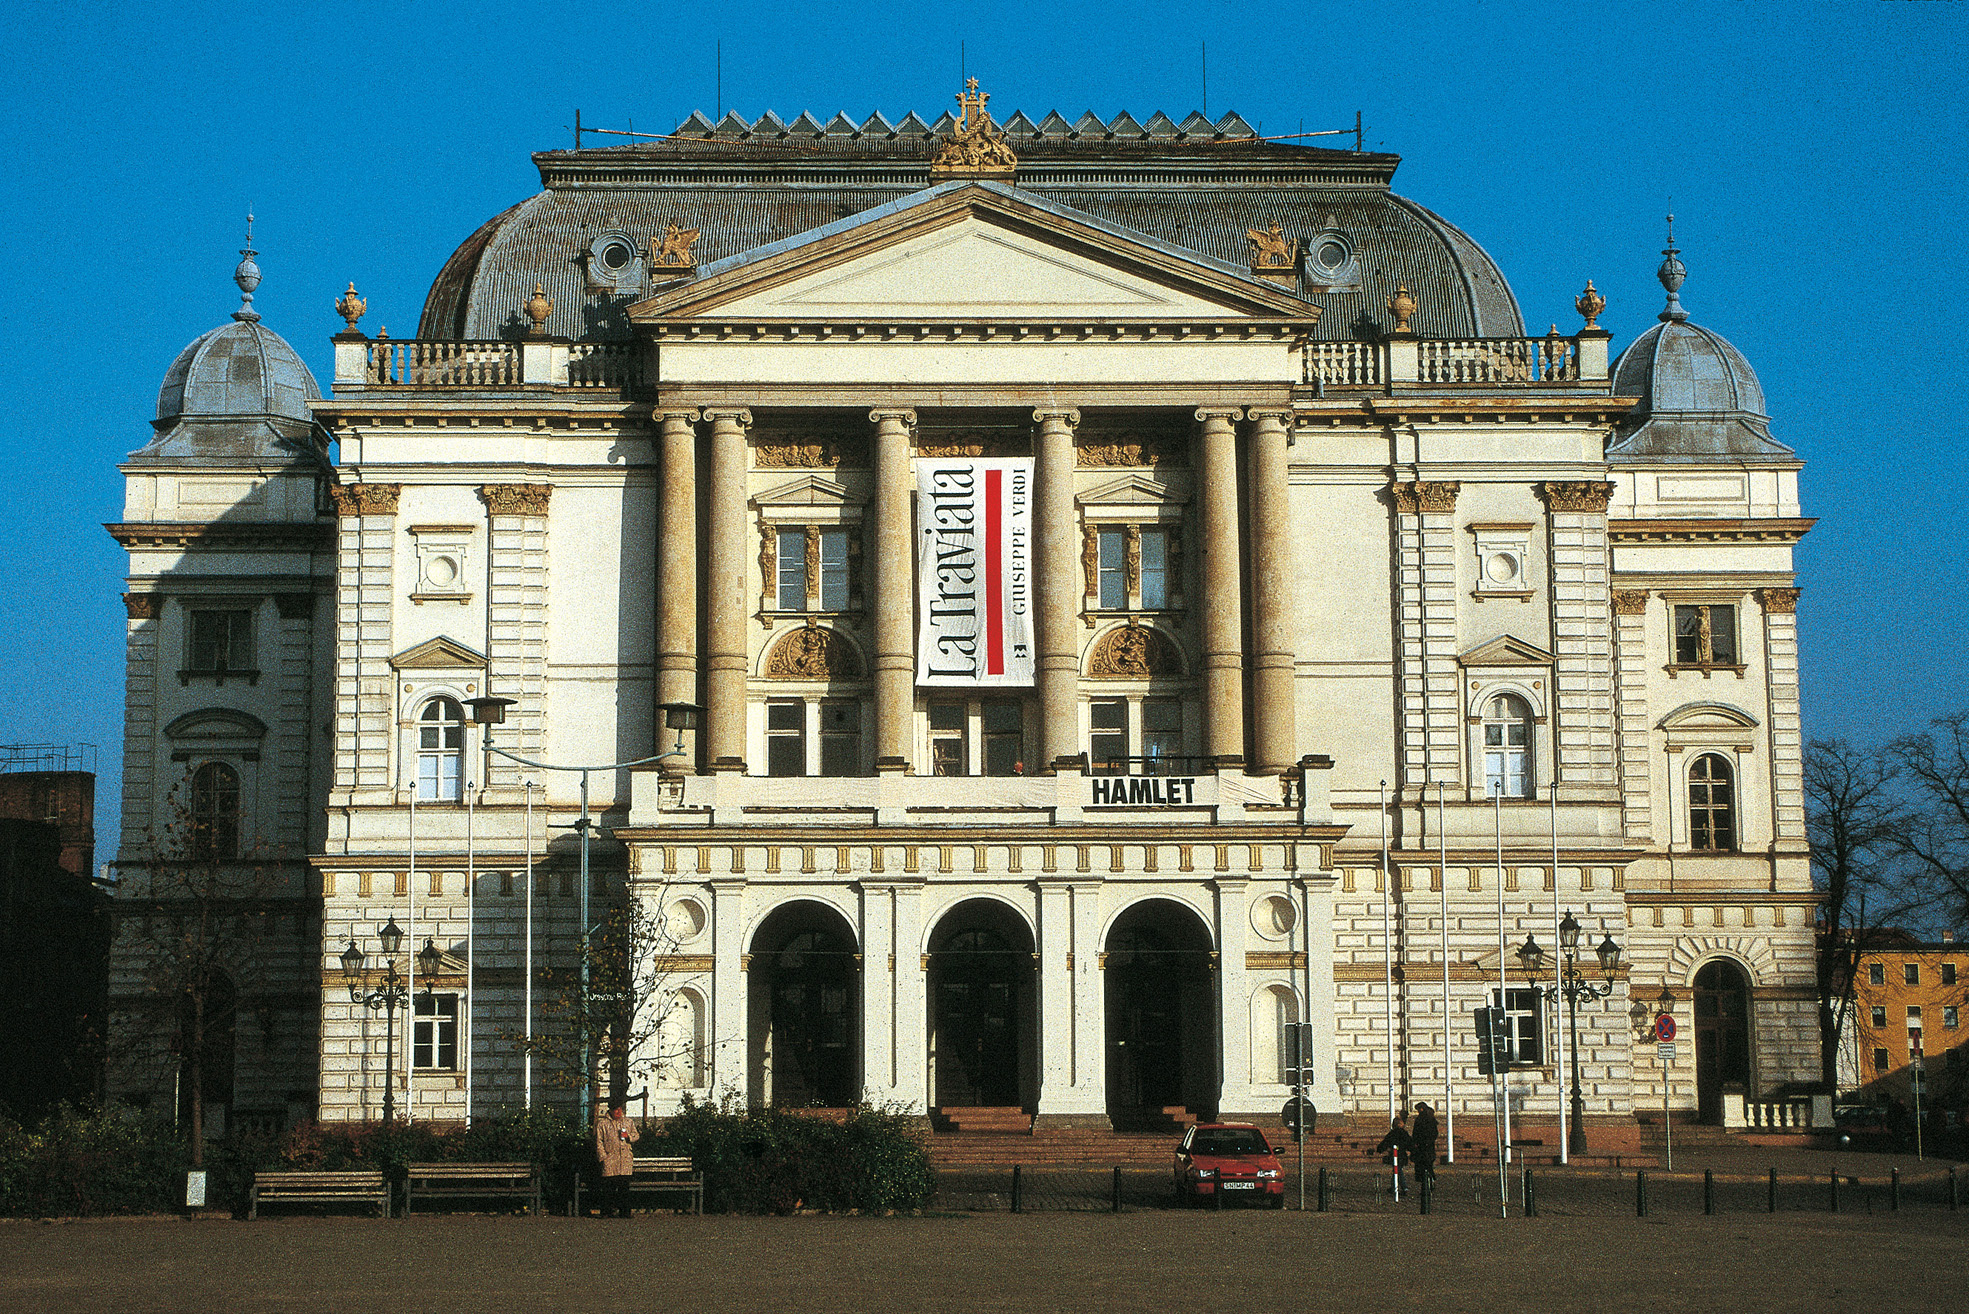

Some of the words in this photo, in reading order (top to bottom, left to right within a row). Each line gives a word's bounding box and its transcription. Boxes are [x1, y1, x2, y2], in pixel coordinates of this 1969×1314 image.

[1012, 469, 1026, 517] VERDI
[924, 464, 977, 627] Traviata
[1012, 527, 1026, 616] GIUSEPPE
[927, 631, 977, 681] La
[1092, 778, 1195, 804] HAMLET
